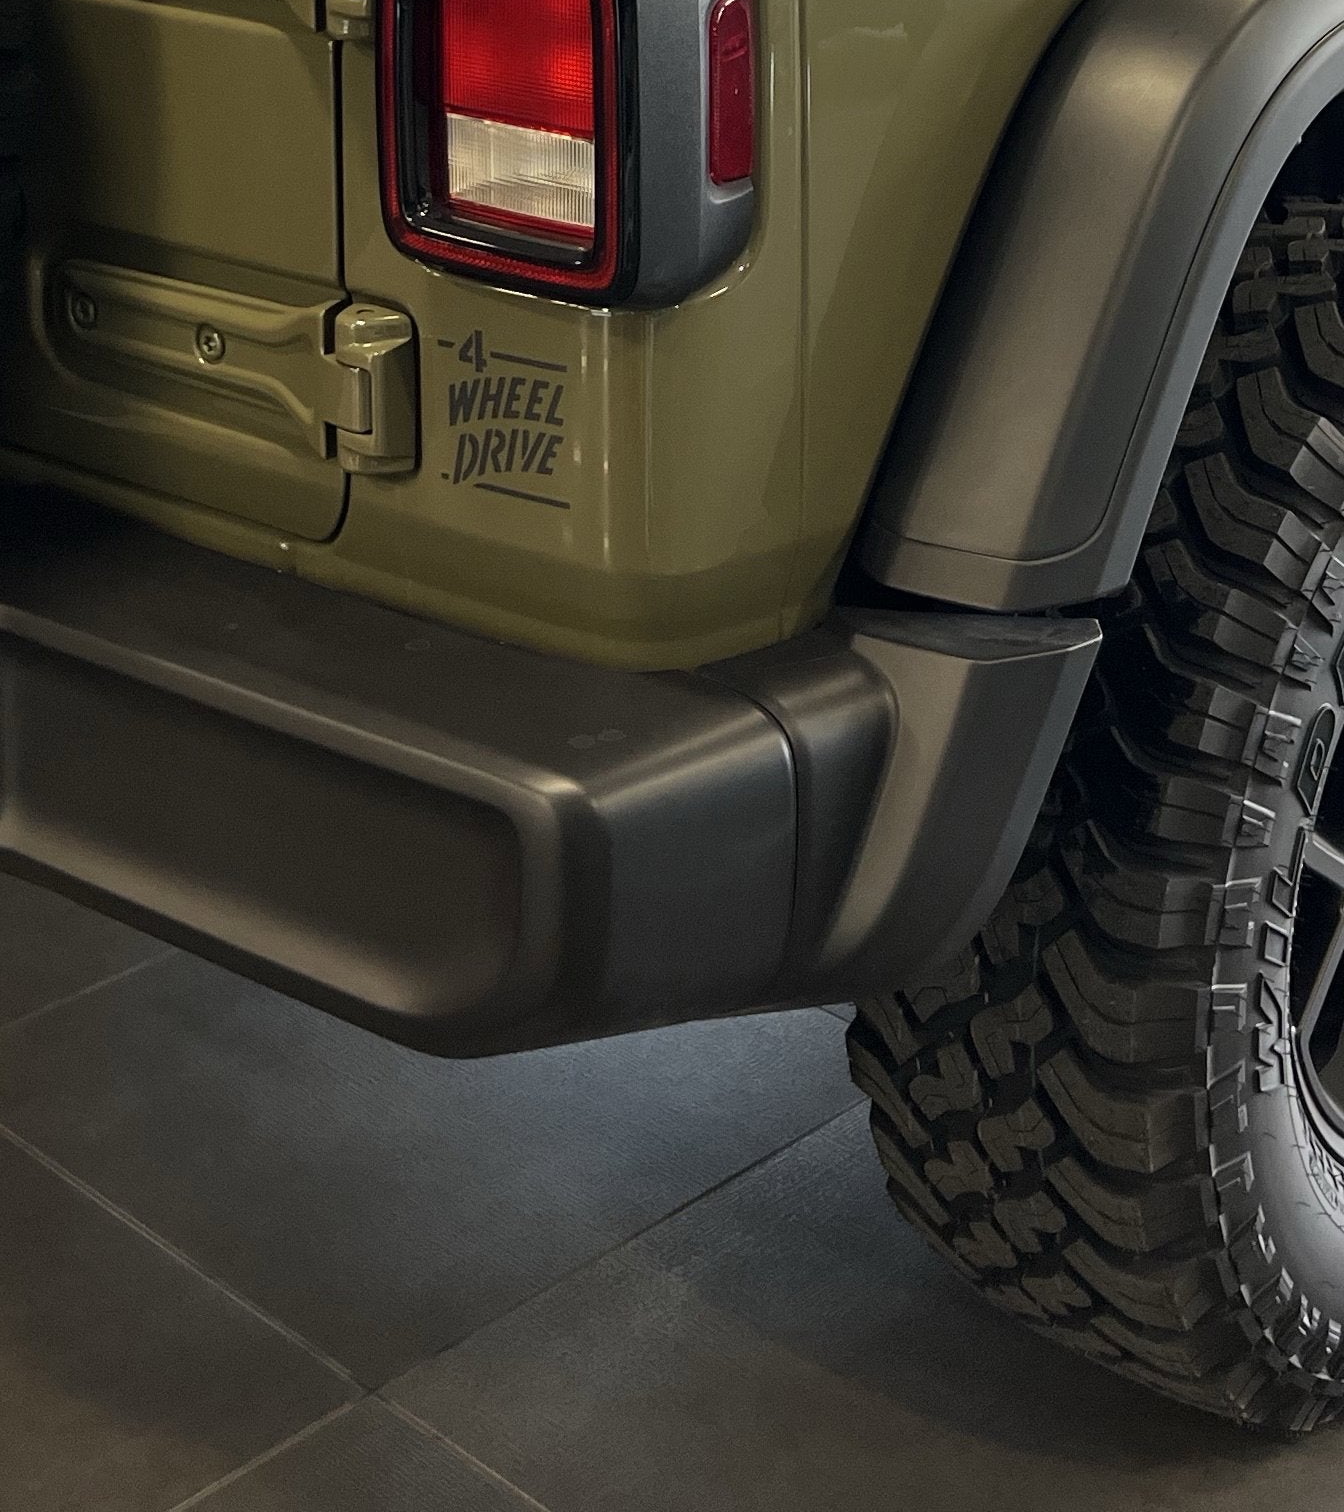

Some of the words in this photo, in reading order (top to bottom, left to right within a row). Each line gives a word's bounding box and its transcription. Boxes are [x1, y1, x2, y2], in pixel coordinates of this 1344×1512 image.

[458, 329, 488, 373] 4
[448, 375, 565, 427] WHEEL
[452, 427, 565, 485] DRIVE
